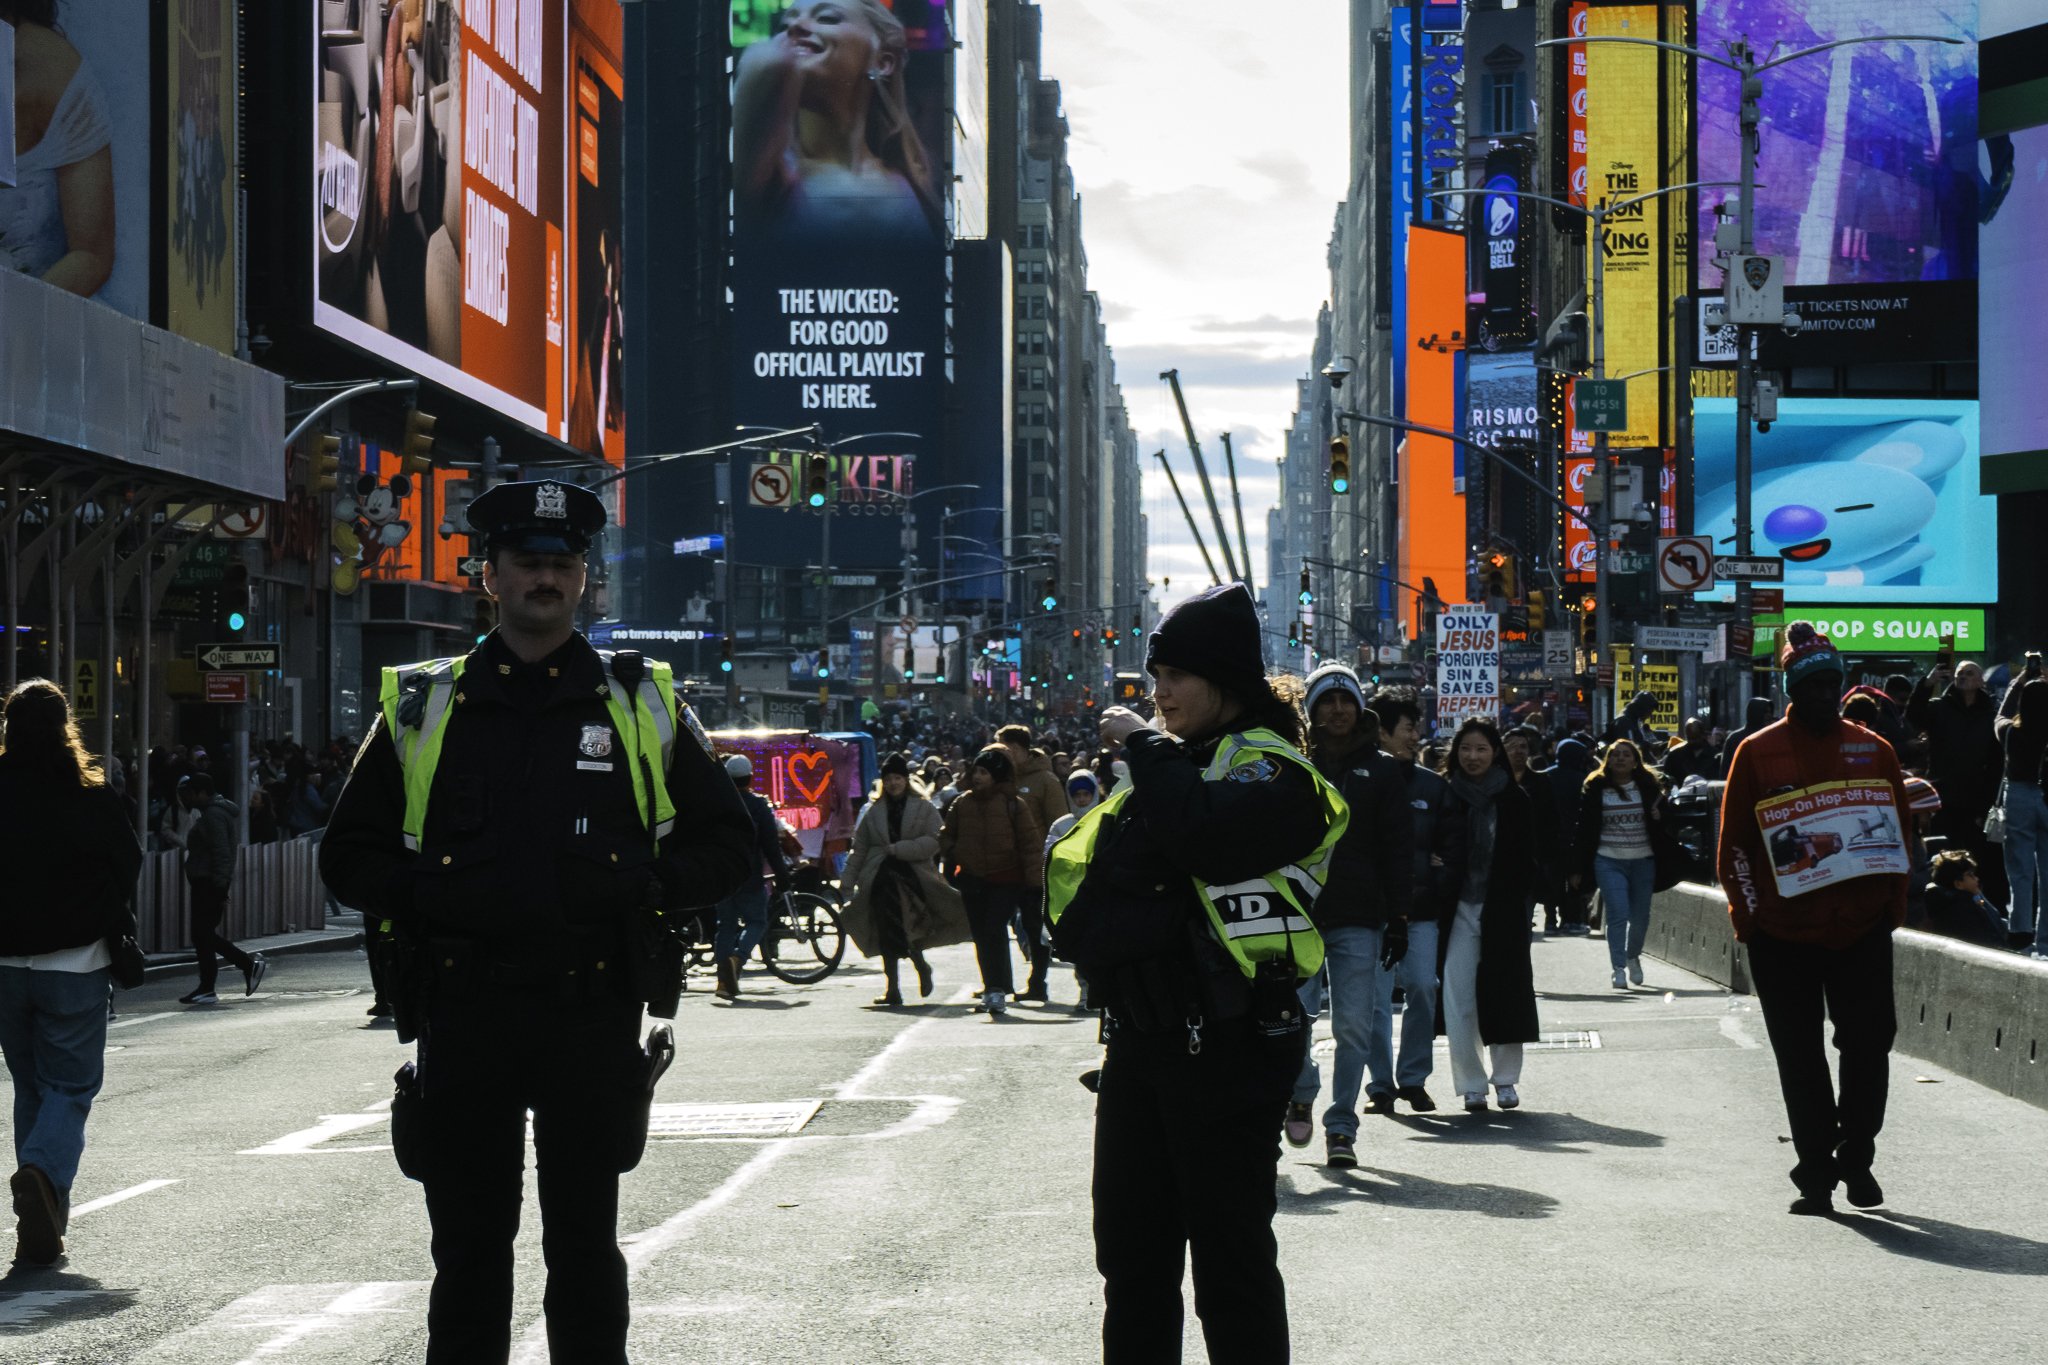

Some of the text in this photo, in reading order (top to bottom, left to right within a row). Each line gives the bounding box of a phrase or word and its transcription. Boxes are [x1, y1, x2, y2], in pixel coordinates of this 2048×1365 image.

[465, 49, 539, 217] ADVENTURE WITH
[1605, 173, 1638, 189] THE
[1488, 239, 1515, 254] TACO
[1602, 228, 1649, 258] KING
[465, 187, 509, 327] EMIRATES
[1490, 255, 1516, 269] BELL
[779, 290, 899, 314] THE WICKED:
[1808, 301, 1858, 312] TICKETS
[1861, 299, 1891, 310] NOW
[1893, 298, 1909, 309] AT
[790, 321, 888, 345] FOR GOOD
[754, 351, 924, 377] OFFICIAL PLAYLIST
[802, 384, 876, 409] IS HERE.
[1593, 386, 1608, 396] TO
[1581, 399, 1620, 410] W 45 St
[196, 546, 212, 562] 46
[1631, 559, 1643, 569] 46
[1716, 563, 1774, 574] ONE WAY
[1443, 616, 1493, 629] ONLY
[1873, 620, 1969, 638] SQUARE
[629, 628, 663, 640] times
[1440, 630, 1495, 651] JESUS
[1647, 629, 1680, 638] PEDESTRIAN
[209, 652, 269, 663] ONE WAY
[1437, 652, 1498, 667] FORGIVES
[1548, 650, 1569, 663] 25
[1447, 669, 1488, 681] SIN &
[78, 663, 93, 709] ATM
[1441, 682, 1494, 694] SAVES
[1438, 697, 1498, 712] REPENT
[1650, 714, 1678, 724] HAND
[772, 756, 784, 805] I
[1764, 800, 1814, 823] Hop-On
[1815, 789, 1863, 807] Hop-Off
[1865, 789, 1890, 801] Pass
